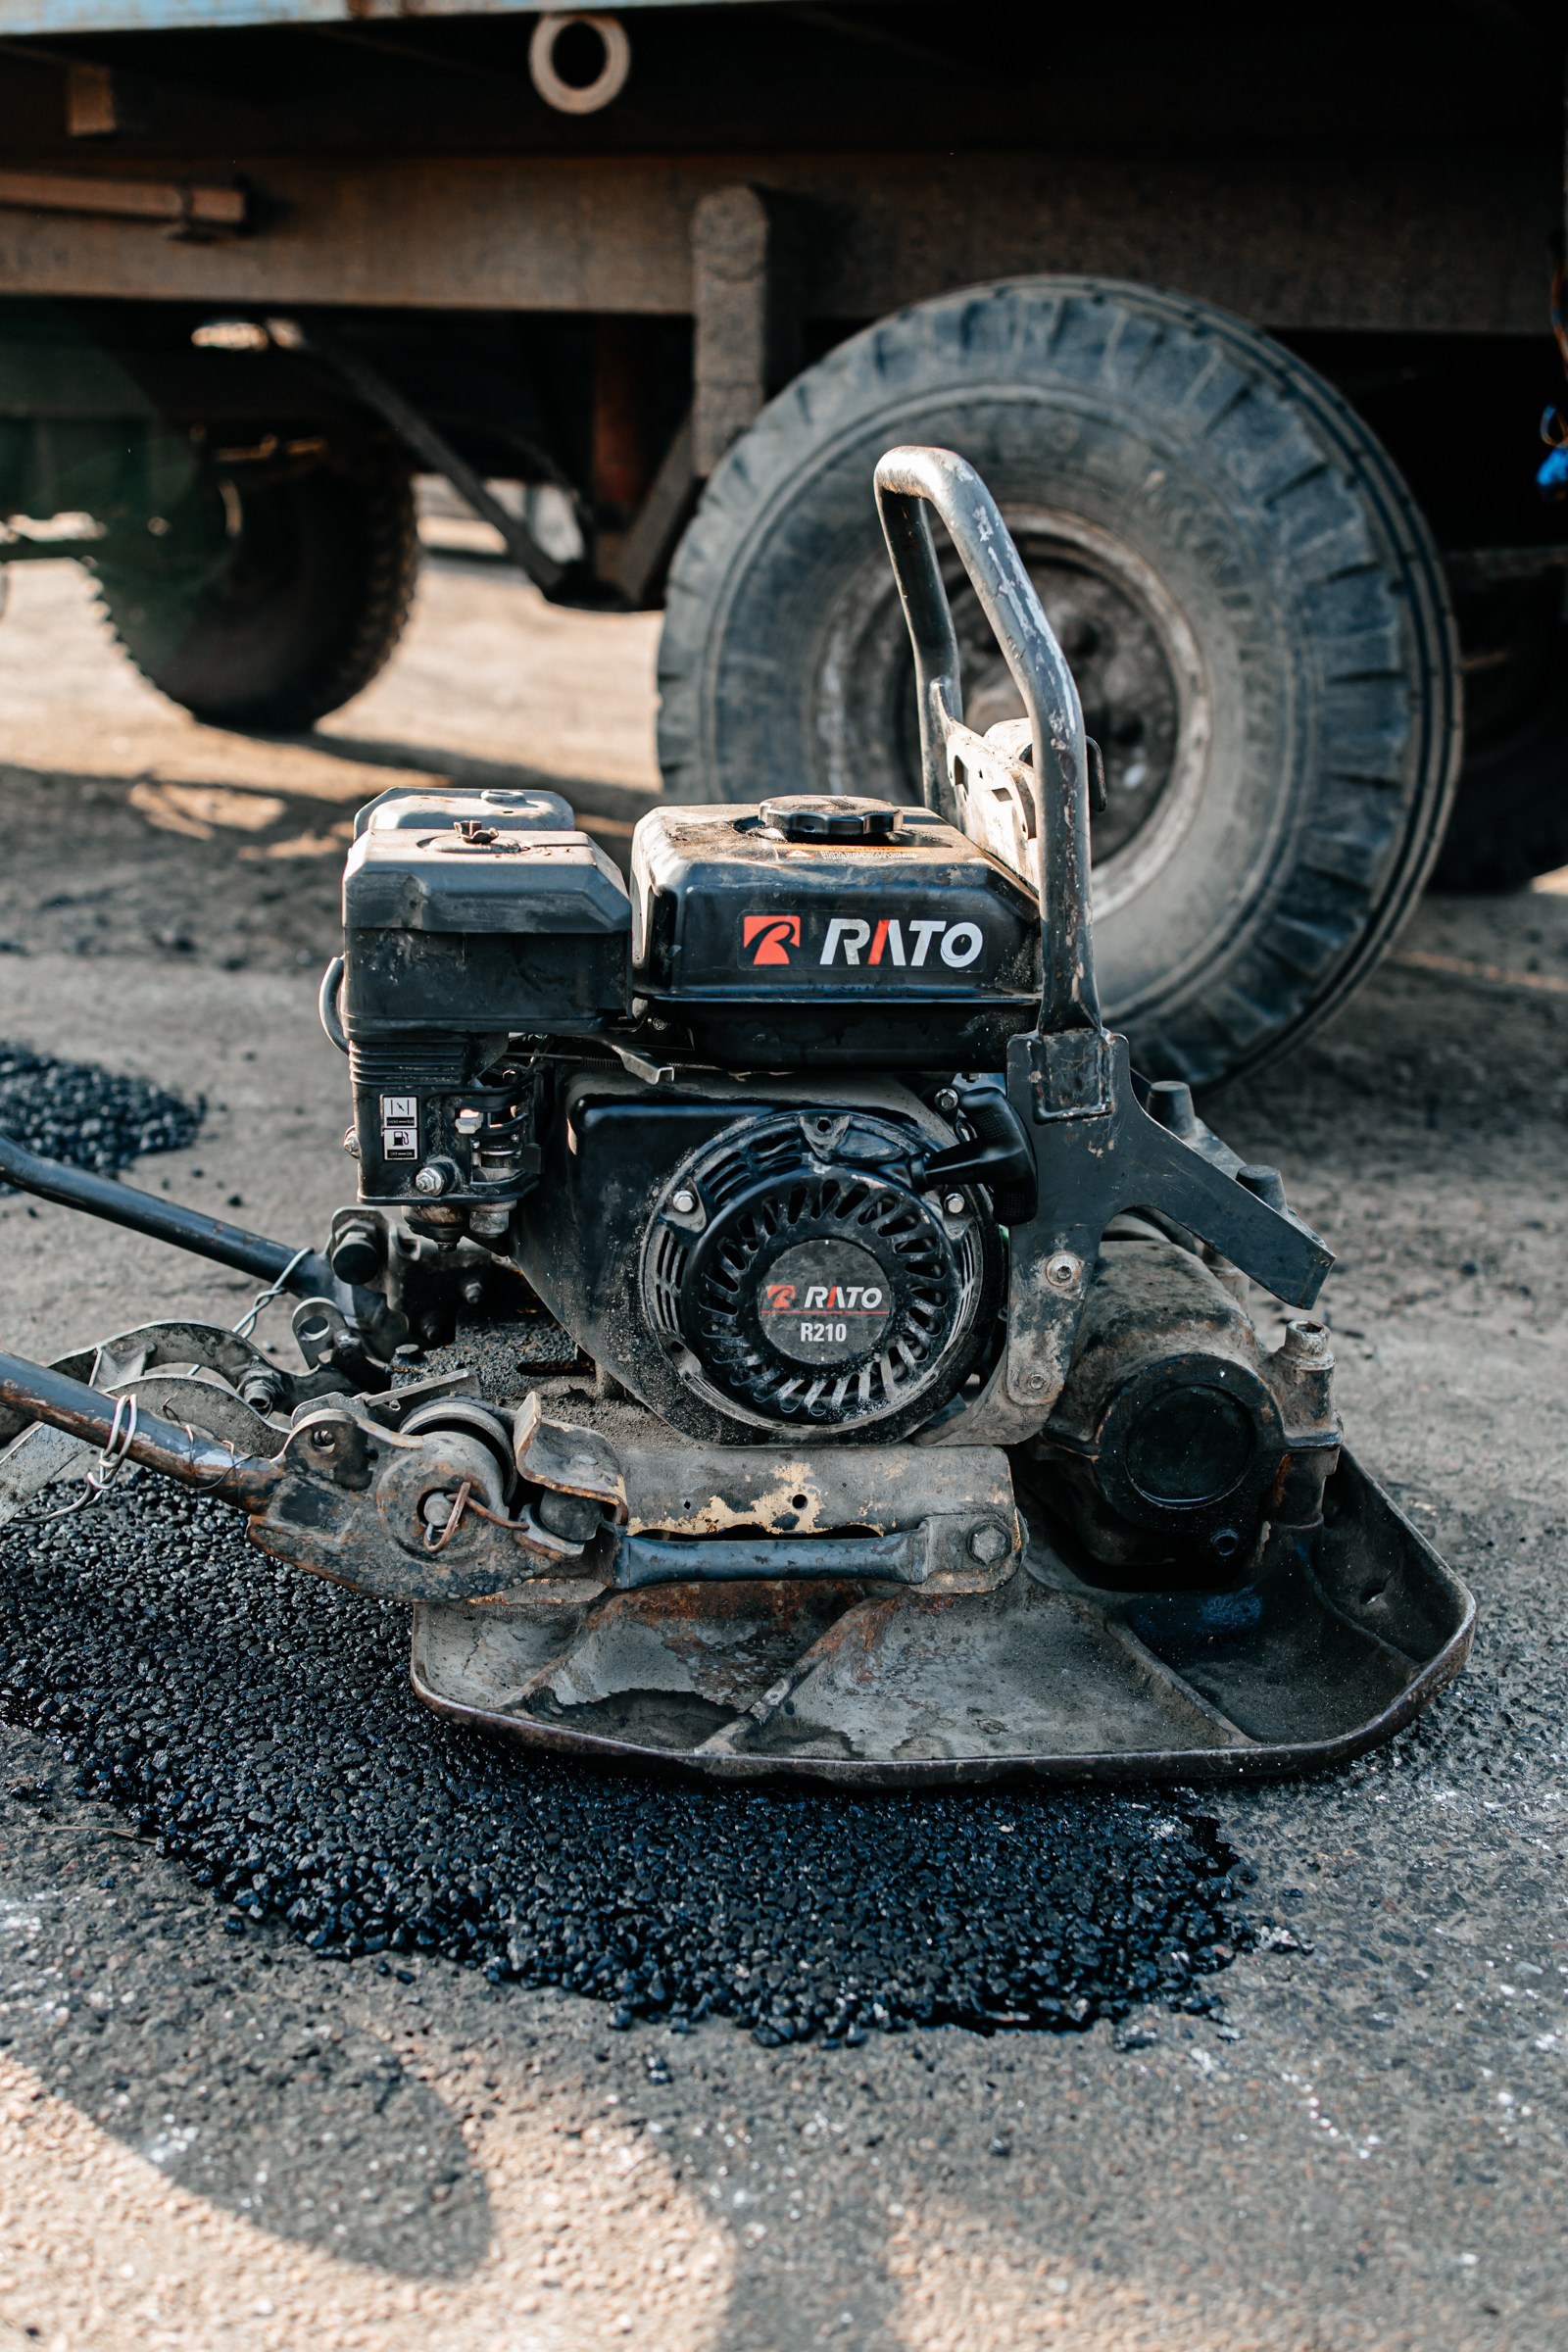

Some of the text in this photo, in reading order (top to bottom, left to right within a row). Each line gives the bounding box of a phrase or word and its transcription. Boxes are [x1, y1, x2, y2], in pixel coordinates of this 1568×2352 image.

[819, 918, 983, 968] RATO
[804, 1286, 883, 1309] RATO
[800, 1322, 847, 1343] R210
